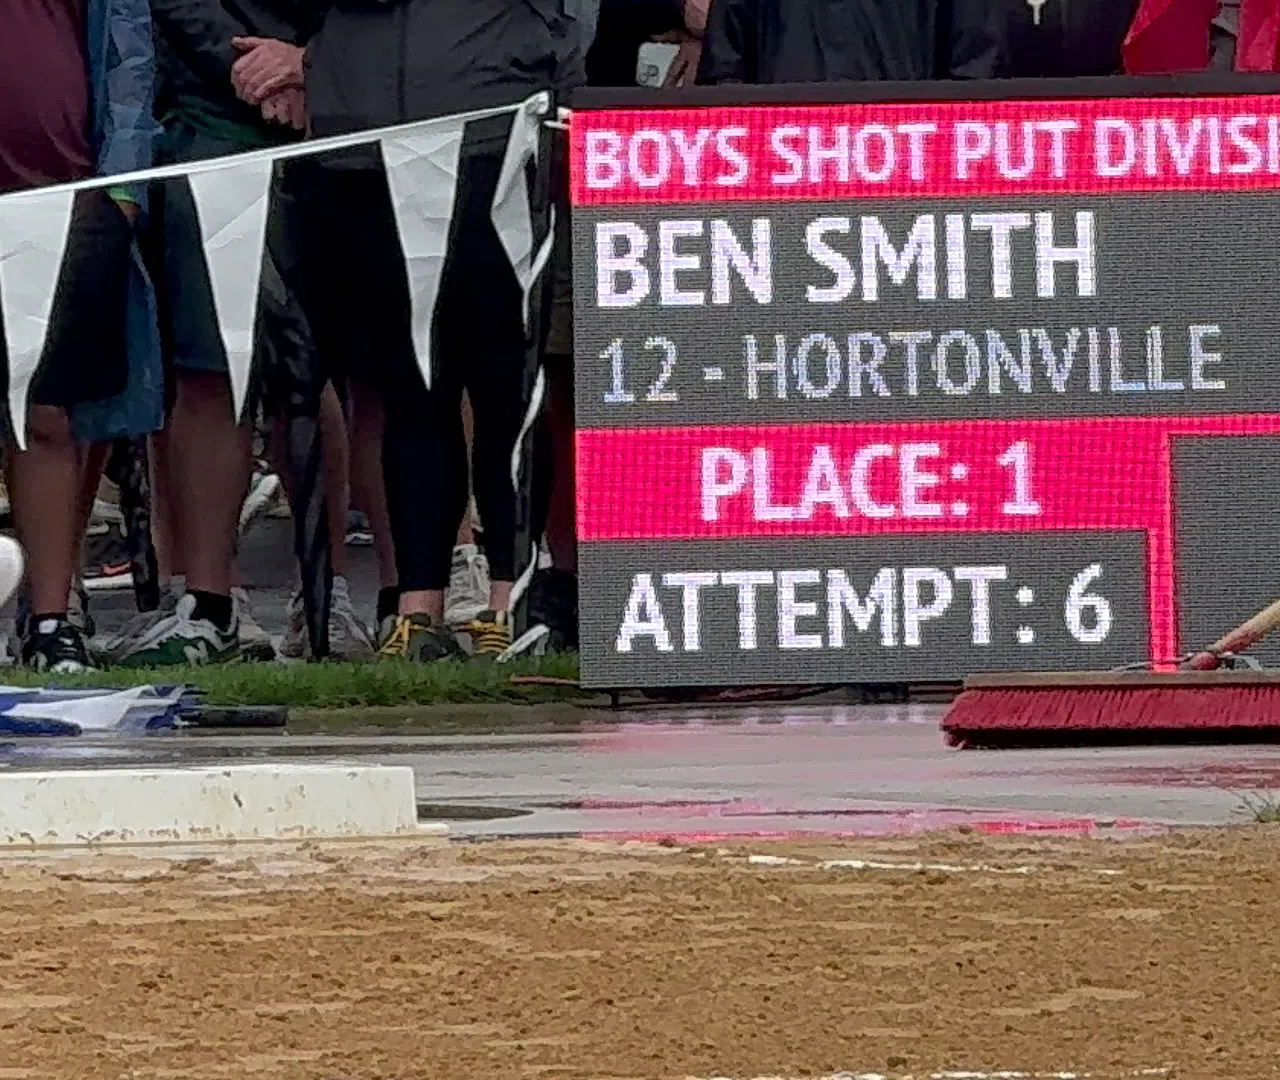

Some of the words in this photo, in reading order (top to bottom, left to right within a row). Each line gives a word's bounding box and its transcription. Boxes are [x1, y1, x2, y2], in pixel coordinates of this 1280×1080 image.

[585, 126, 748, 188] BOYS
[771, 122, 936, 184] SHOT
[953, 120, 1081, 180] PUT
[596, 218, 772, 307] BEN
[803, 211, 1096, 303] SMITH
[599, 335, 679, 403] 12
[703, 366, 725, 380] -
[744, 325, 1226, 400] HORTONVILLE
[701, 443, 970, 521] PLACE:
[997, 440, 1043, 515] 1
[616, 565, 1035, 651] ATTEMPT:
[1064, 563, 1113, 643] 6
